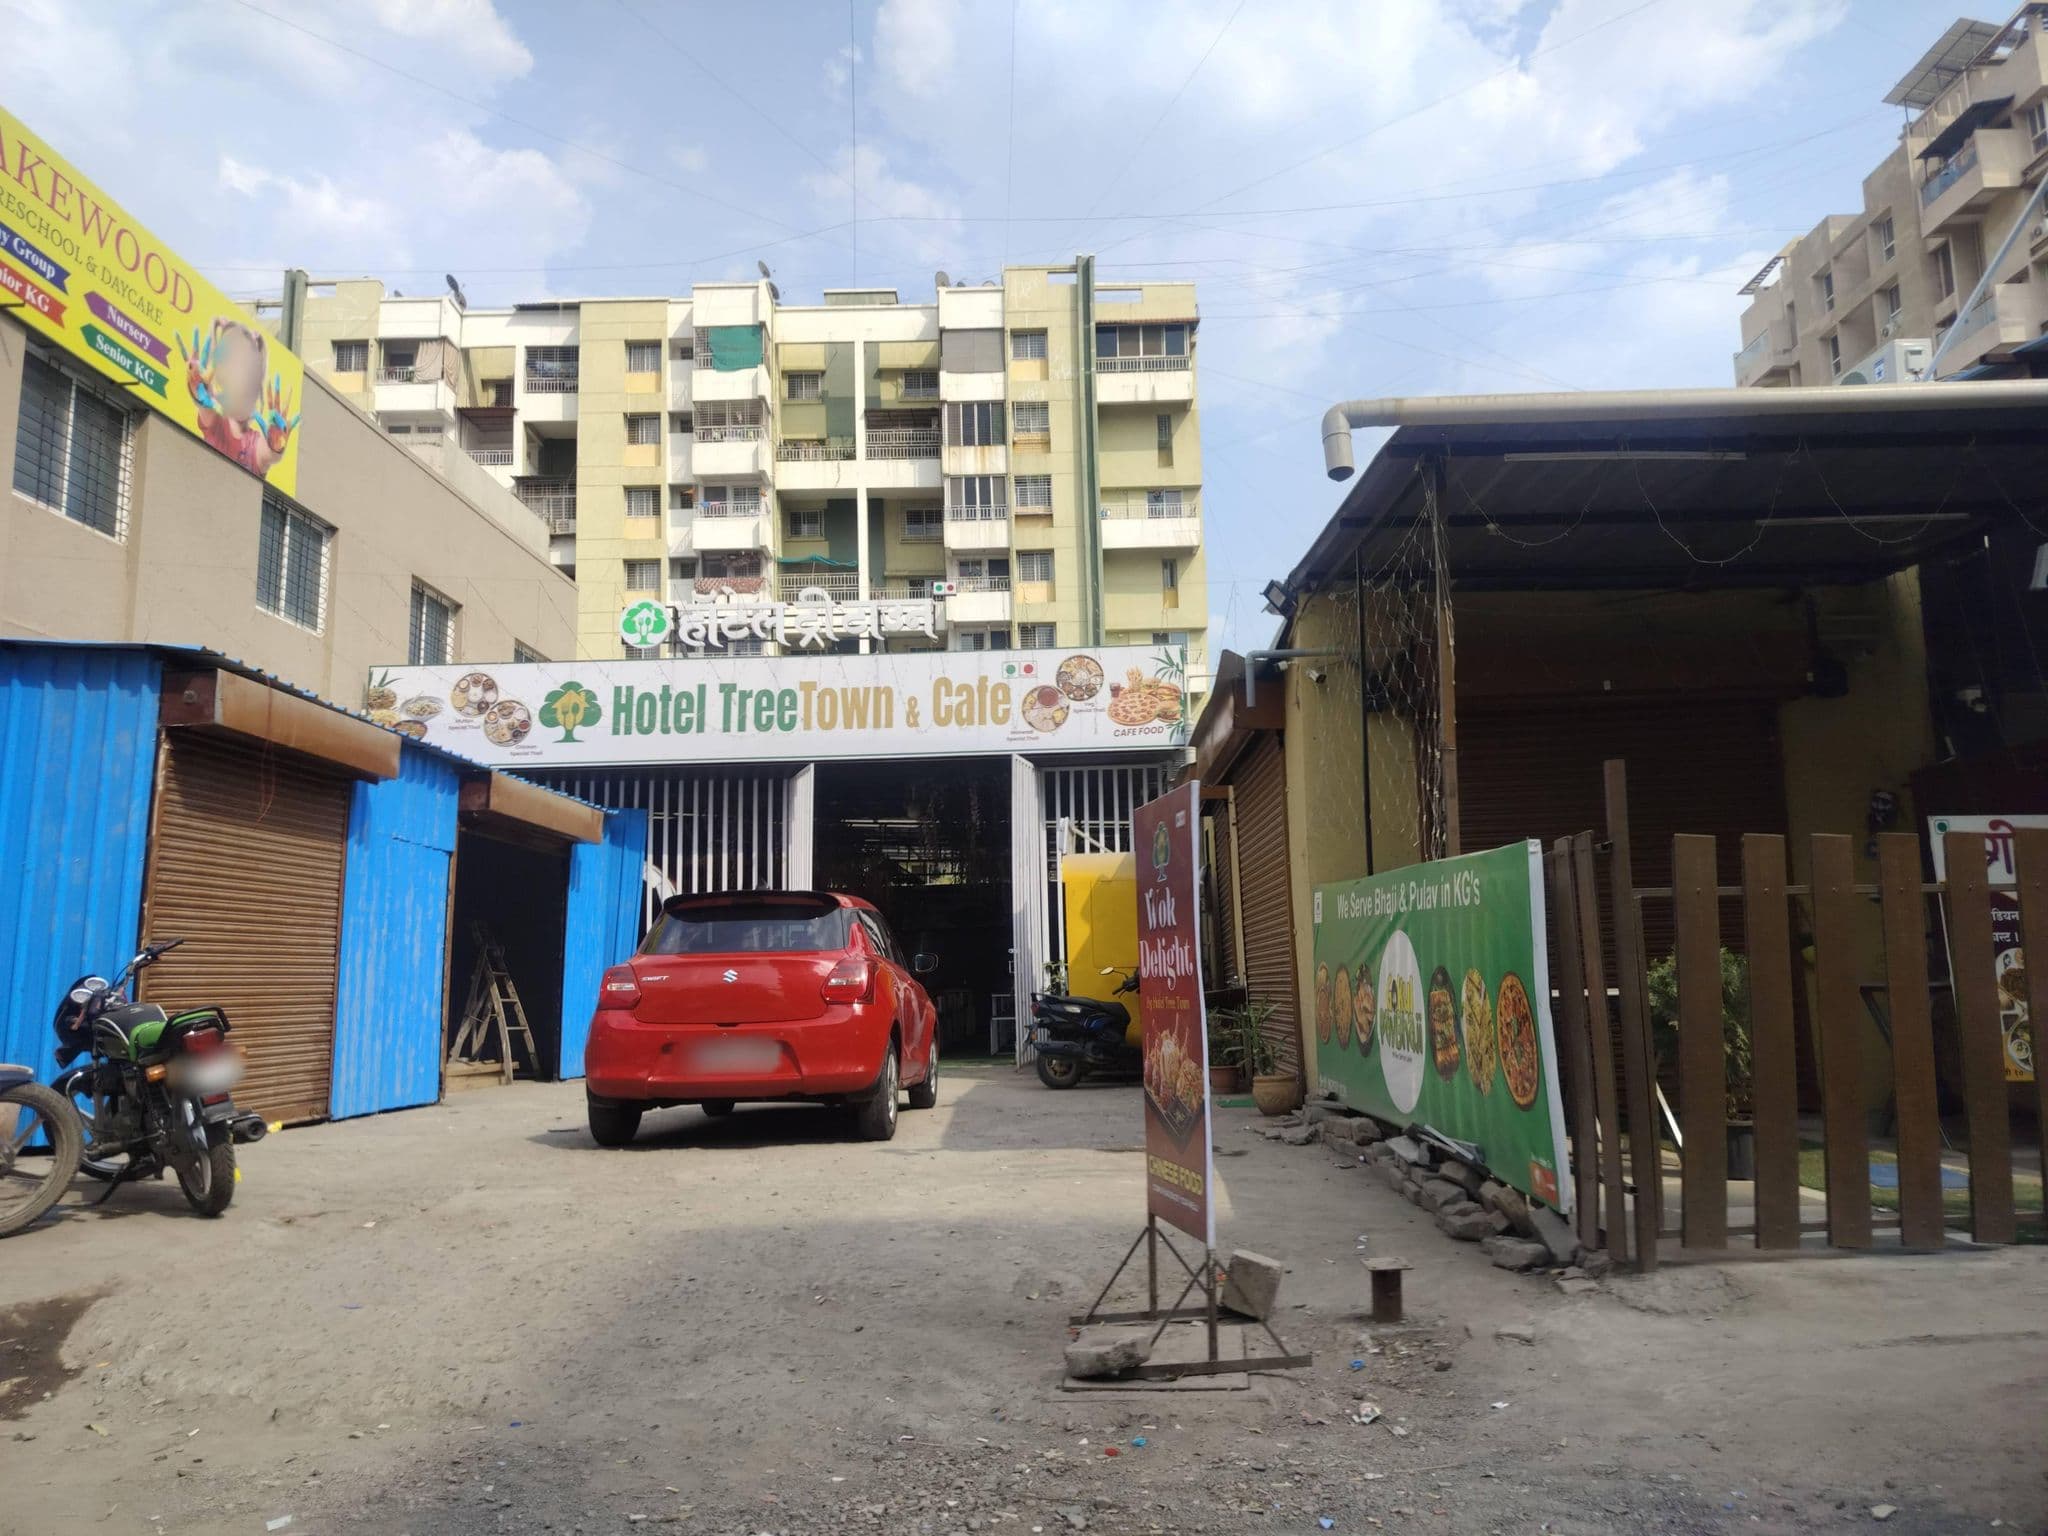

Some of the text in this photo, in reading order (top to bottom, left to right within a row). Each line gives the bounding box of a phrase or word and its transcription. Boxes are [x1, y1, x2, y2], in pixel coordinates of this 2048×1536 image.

[13, 237, 56, 279] Group
[25, 283, 50, 313] KG
[86, 256, 97, 277] &
[101, 267, 164, 326] DAYCARE
[107, 305, 152, 350] Nursery
[95, 334, 155, 385] Senior KG
[612, 683, 707, 735] Hotel
[905, 695, 921, 728] &
[932, 675, 1012, 727] Cafe
[1113, 725, 1164, 737] CAFE FOOD
[1144, 886, 1177, 930] Wok
[1337, 871, 1480, 921] We Serve Bhaji & Pulav in KG's
[1140, 936, 1194, 991] Delight
[1179, 1166, 1203, 1195] FOOD
